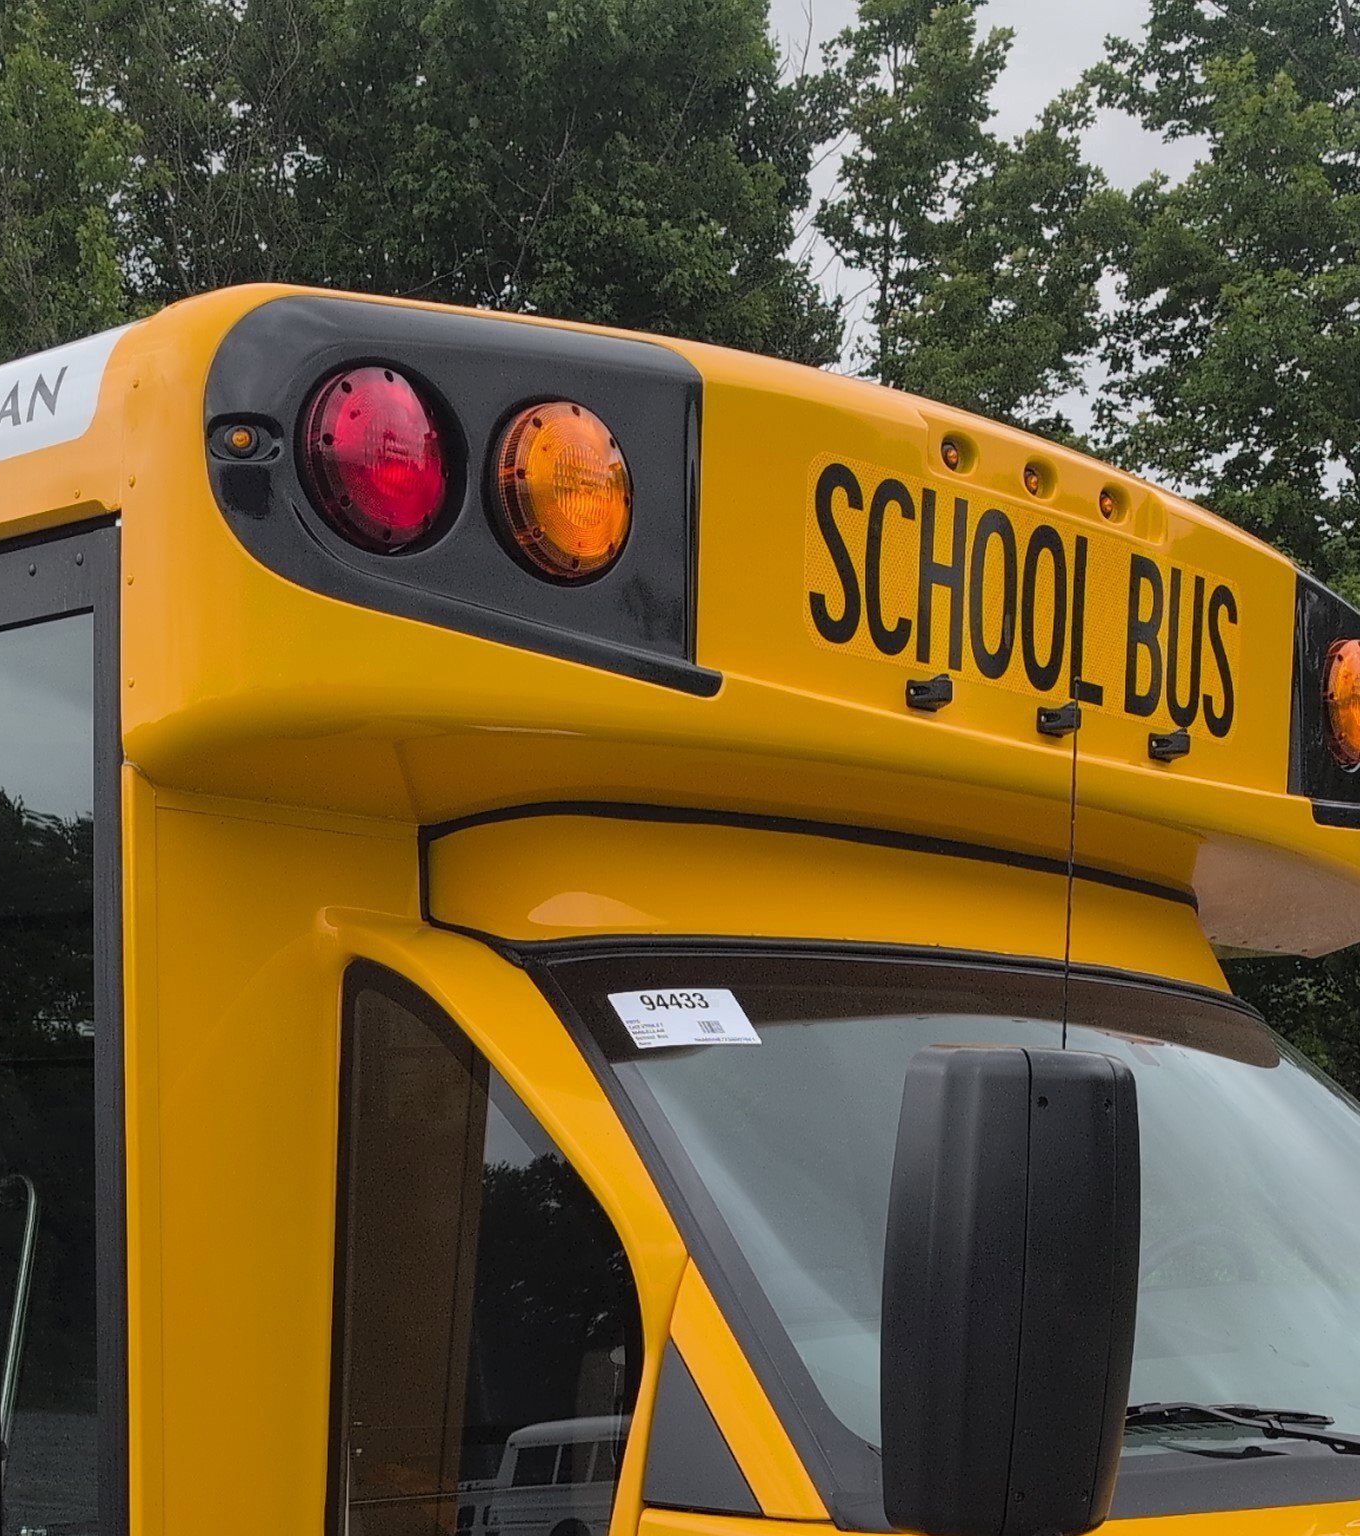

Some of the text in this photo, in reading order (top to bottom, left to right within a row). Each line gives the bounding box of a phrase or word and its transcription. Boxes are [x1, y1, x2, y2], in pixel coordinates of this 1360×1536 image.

[809, 462, 1238, 738] SCHOOL BUS
[639, 992, 709, 1011] 94433
